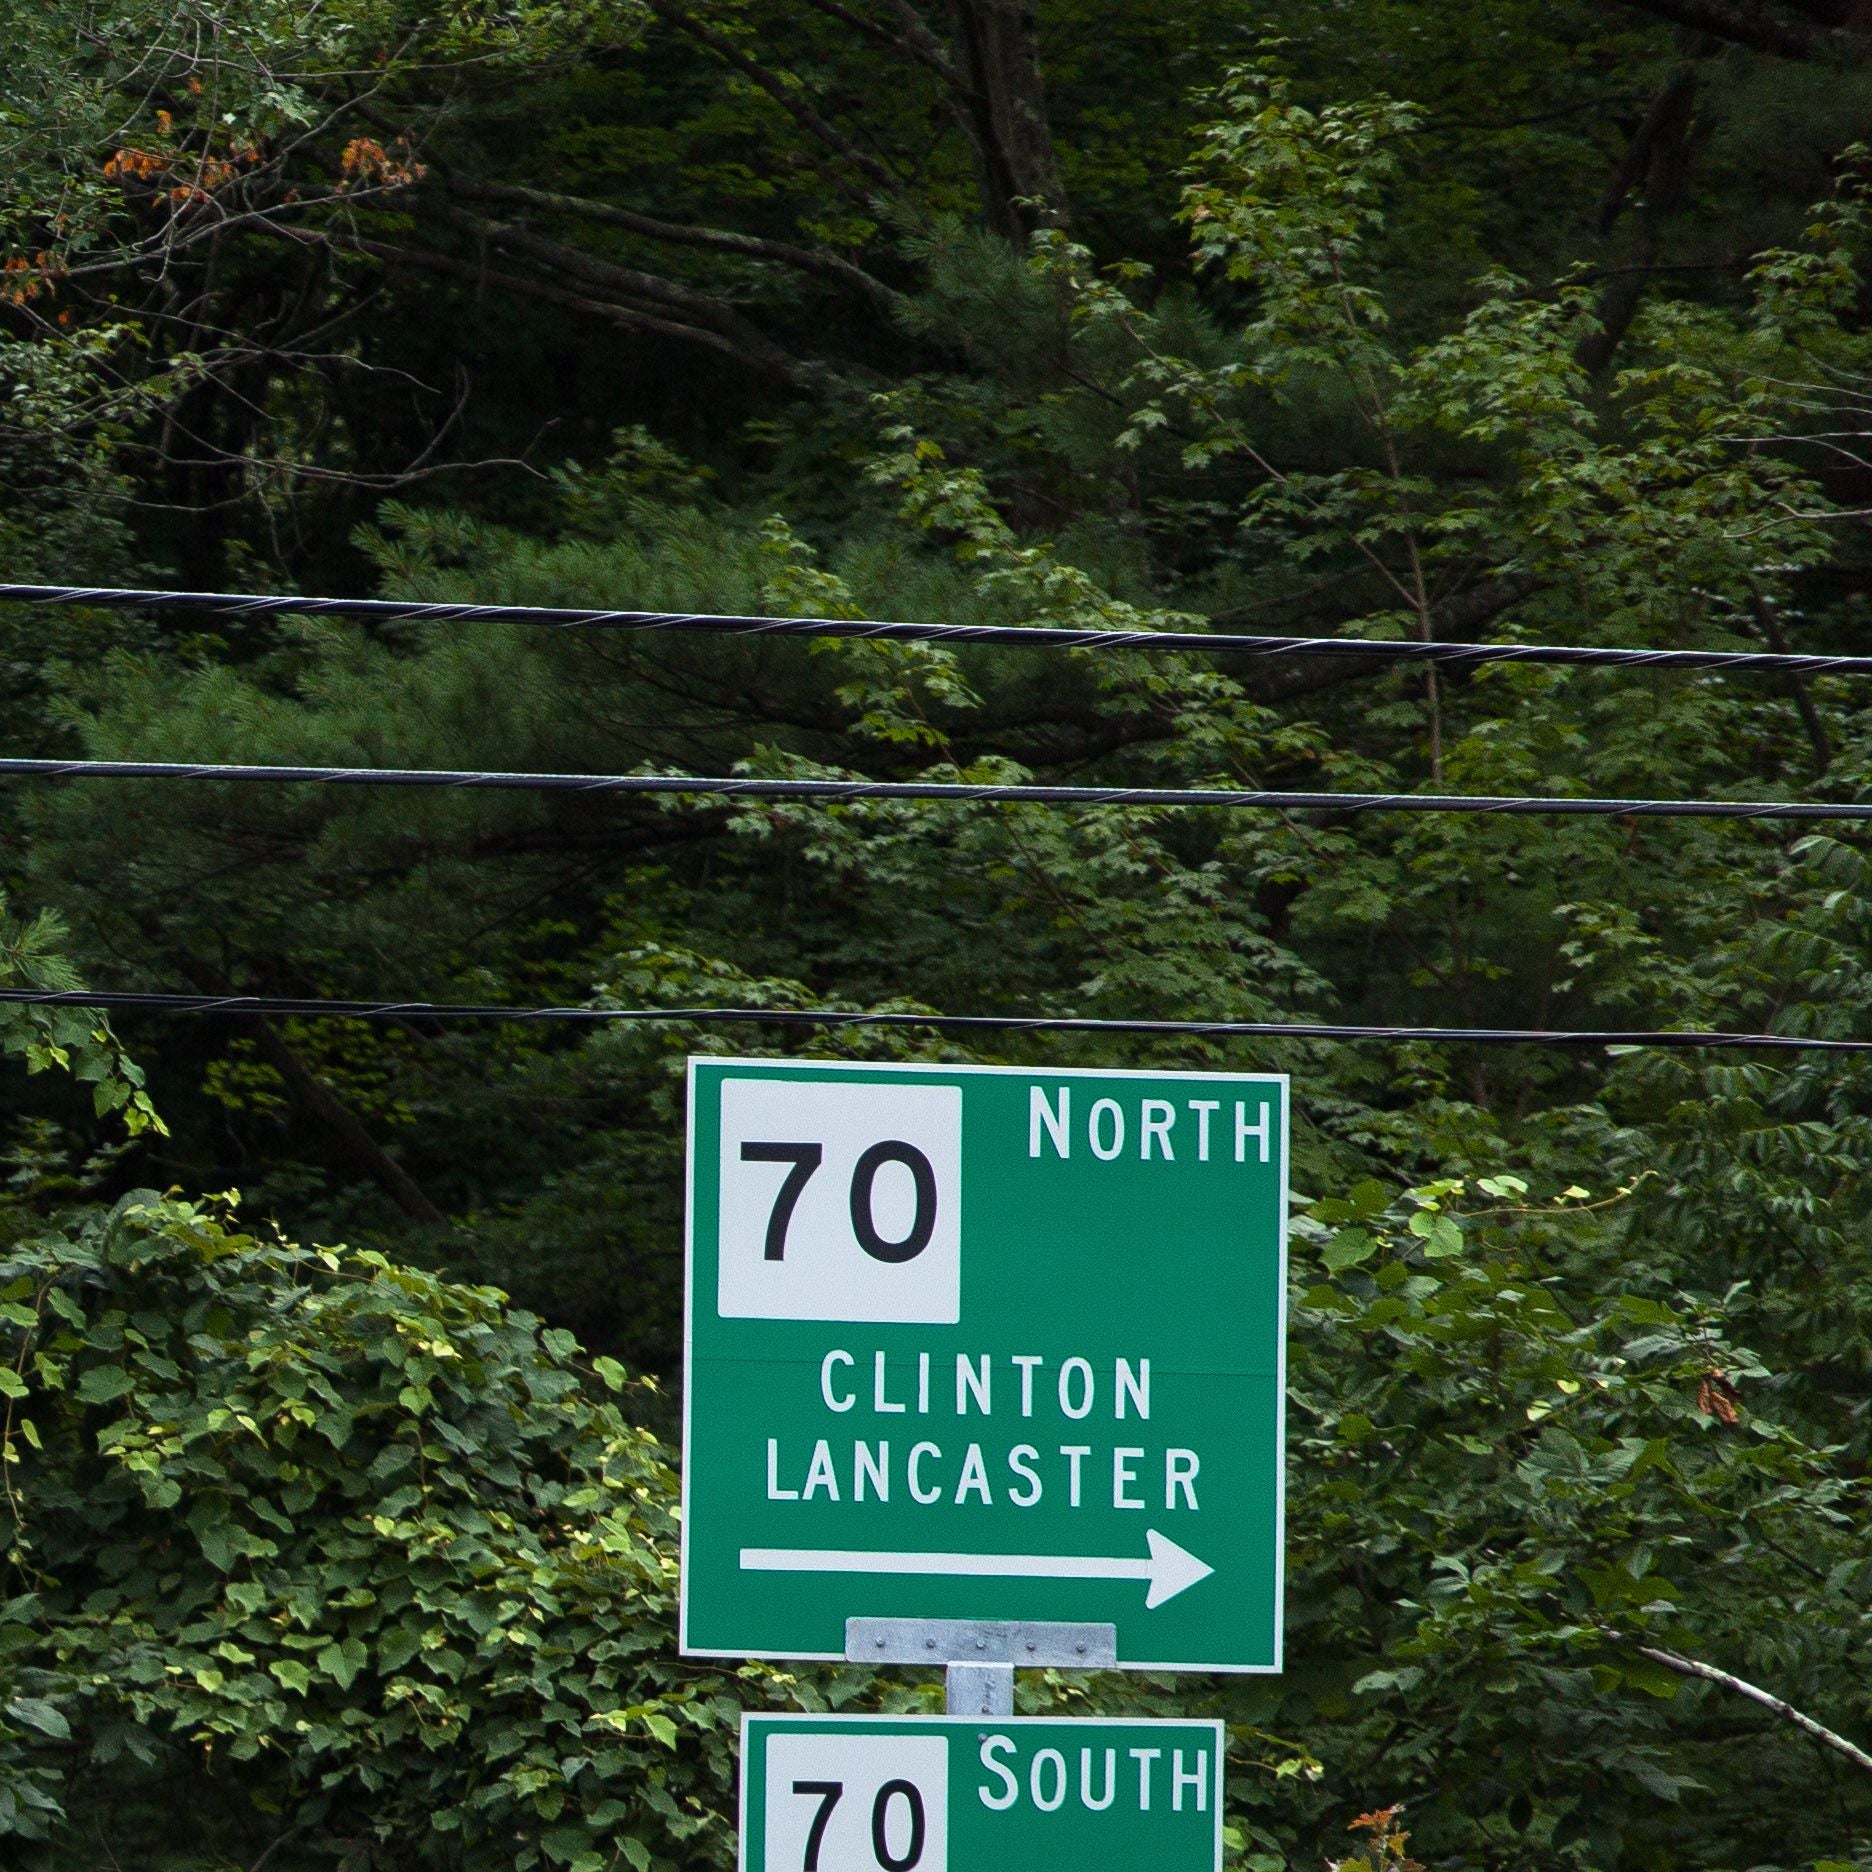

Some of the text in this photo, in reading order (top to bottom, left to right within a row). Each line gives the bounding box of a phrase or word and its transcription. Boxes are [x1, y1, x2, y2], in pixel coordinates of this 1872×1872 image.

[1029, 1085, 1271, 1163] NORTH
[740, 1139, 937, 1263] 70
[820, 1349, 1151, 1420] CLINTON
[766, 1438, 1201, 1510] LANCASTER
[978, 1734, 1208, 1812] SOUTH
